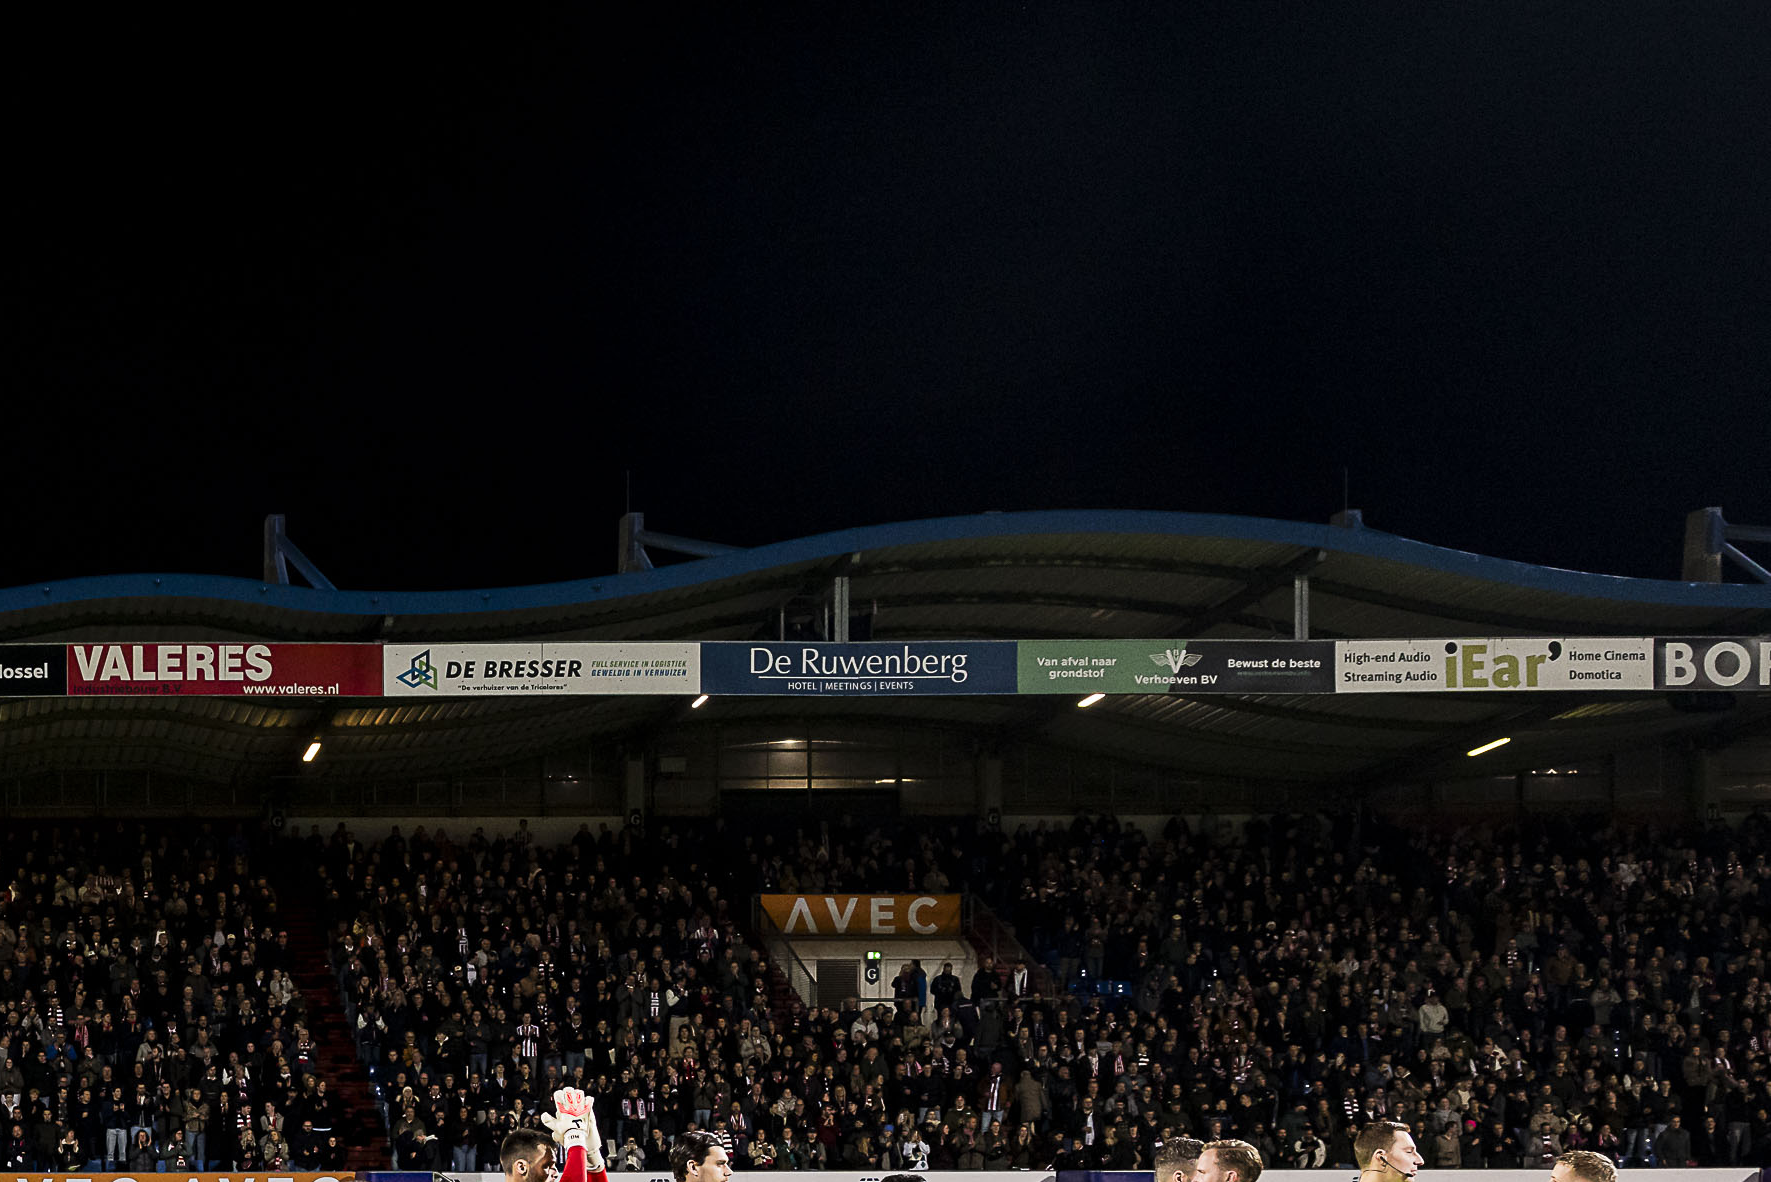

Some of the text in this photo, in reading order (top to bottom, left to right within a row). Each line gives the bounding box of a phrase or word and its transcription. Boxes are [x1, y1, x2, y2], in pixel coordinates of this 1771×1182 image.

[1037, 656, 1117, 667] Van afval naar
[1344, 652, 1431, 665] High-end Audio
[1569, 649, 1646, 662] Home Cinema
[73, 645, 273, 681] VALERES
[446, 660, 583, 678] DE BRESSER
[591, 660, 608, 668] FULL
[750, 646, 968, 683] De Ruwenberg
[1227, 658, 1321, 669] Bewust de beste
[1665, 641, 1771, 687] BO
[1049, 668, 1105, 680] grondstof
[1134, 675, 1218, 685] Verhoeven BV
[1344, 671, 1438, 684] Streaming Audio
[1569, 669, 1622, 681] Domotica
[243, 683, 339, 695] www.valeres.nl
[788, 681, 914, 692] HOTEL MEETINGS EVENTS
[783, 897, 938, 934] AVEC
[867, 968, 876, 979] G
